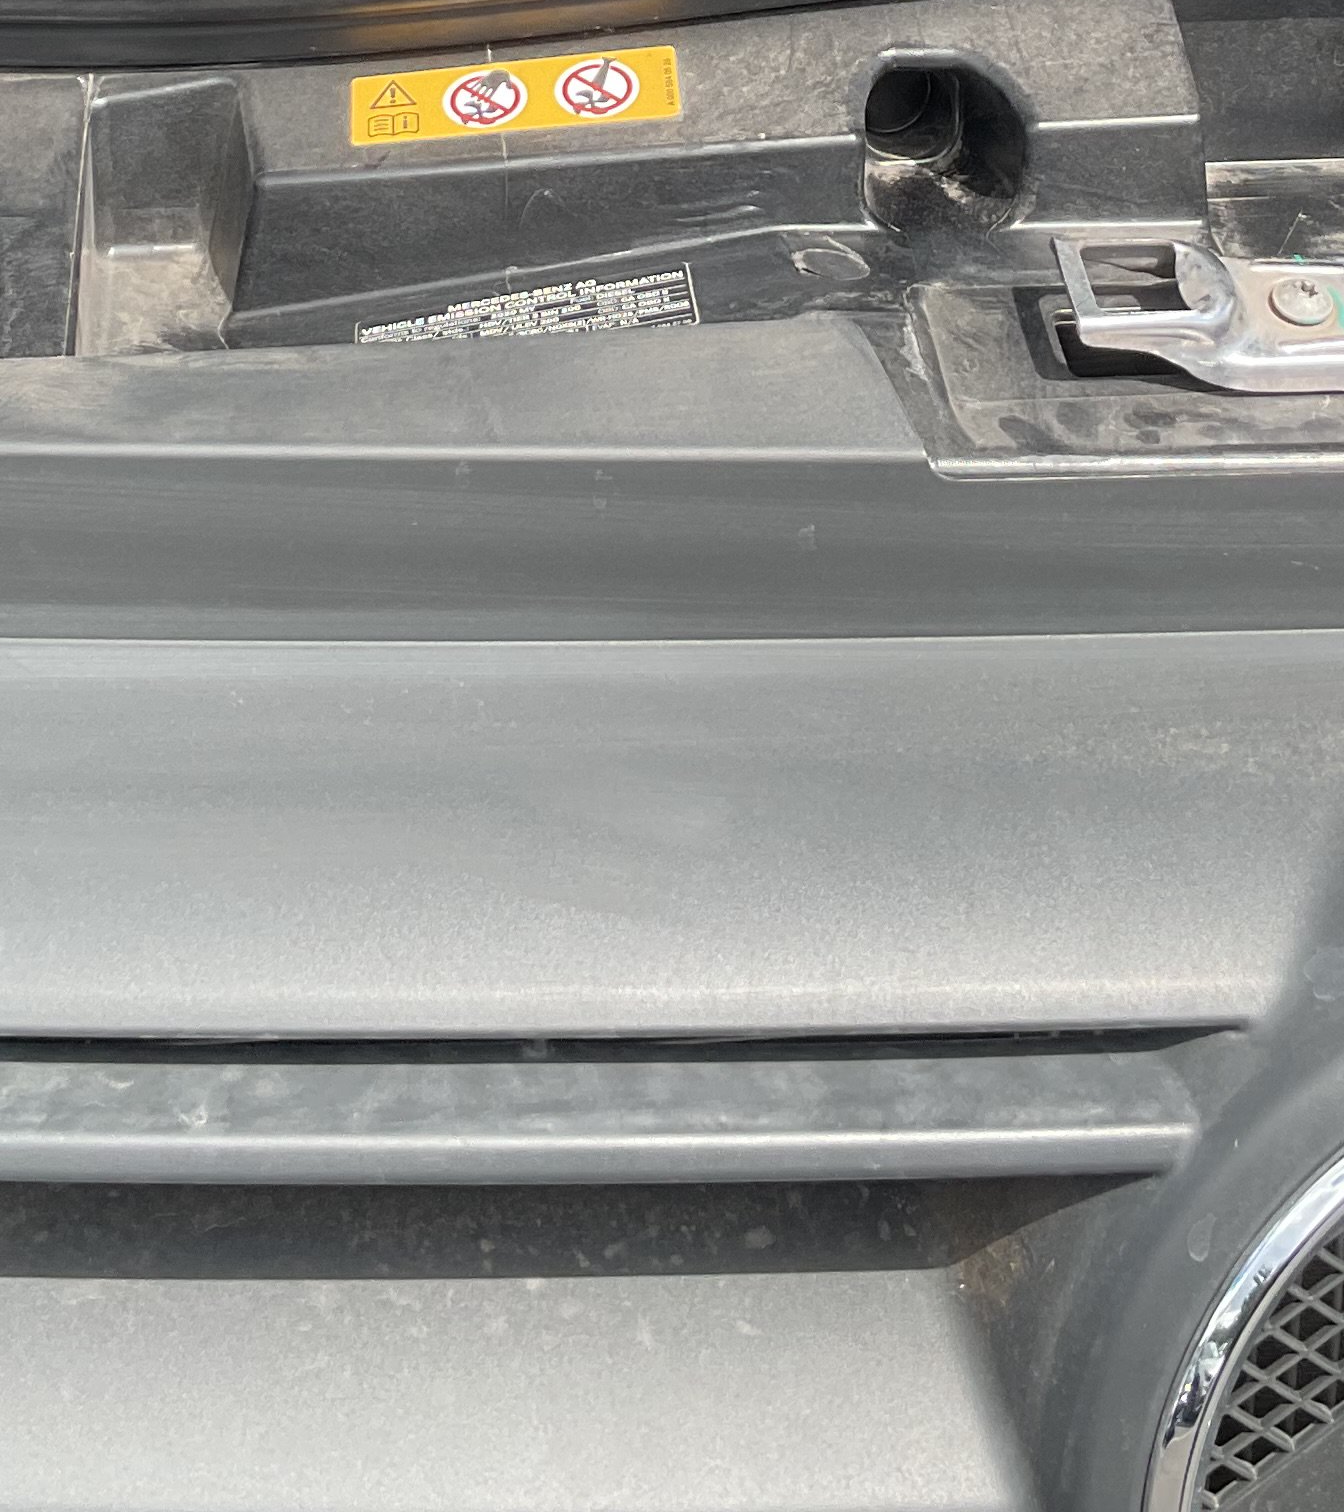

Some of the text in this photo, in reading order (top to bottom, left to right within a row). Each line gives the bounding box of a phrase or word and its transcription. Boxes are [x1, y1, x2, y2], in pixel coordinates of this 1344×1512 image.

[361, 269, 684, 336] VEHICLE EMISSION CONTROL INFORMATION
[447, 279, 597, 313] MERCEDES-BENZ AG
[596, 288, 636, 300] DIESEL
